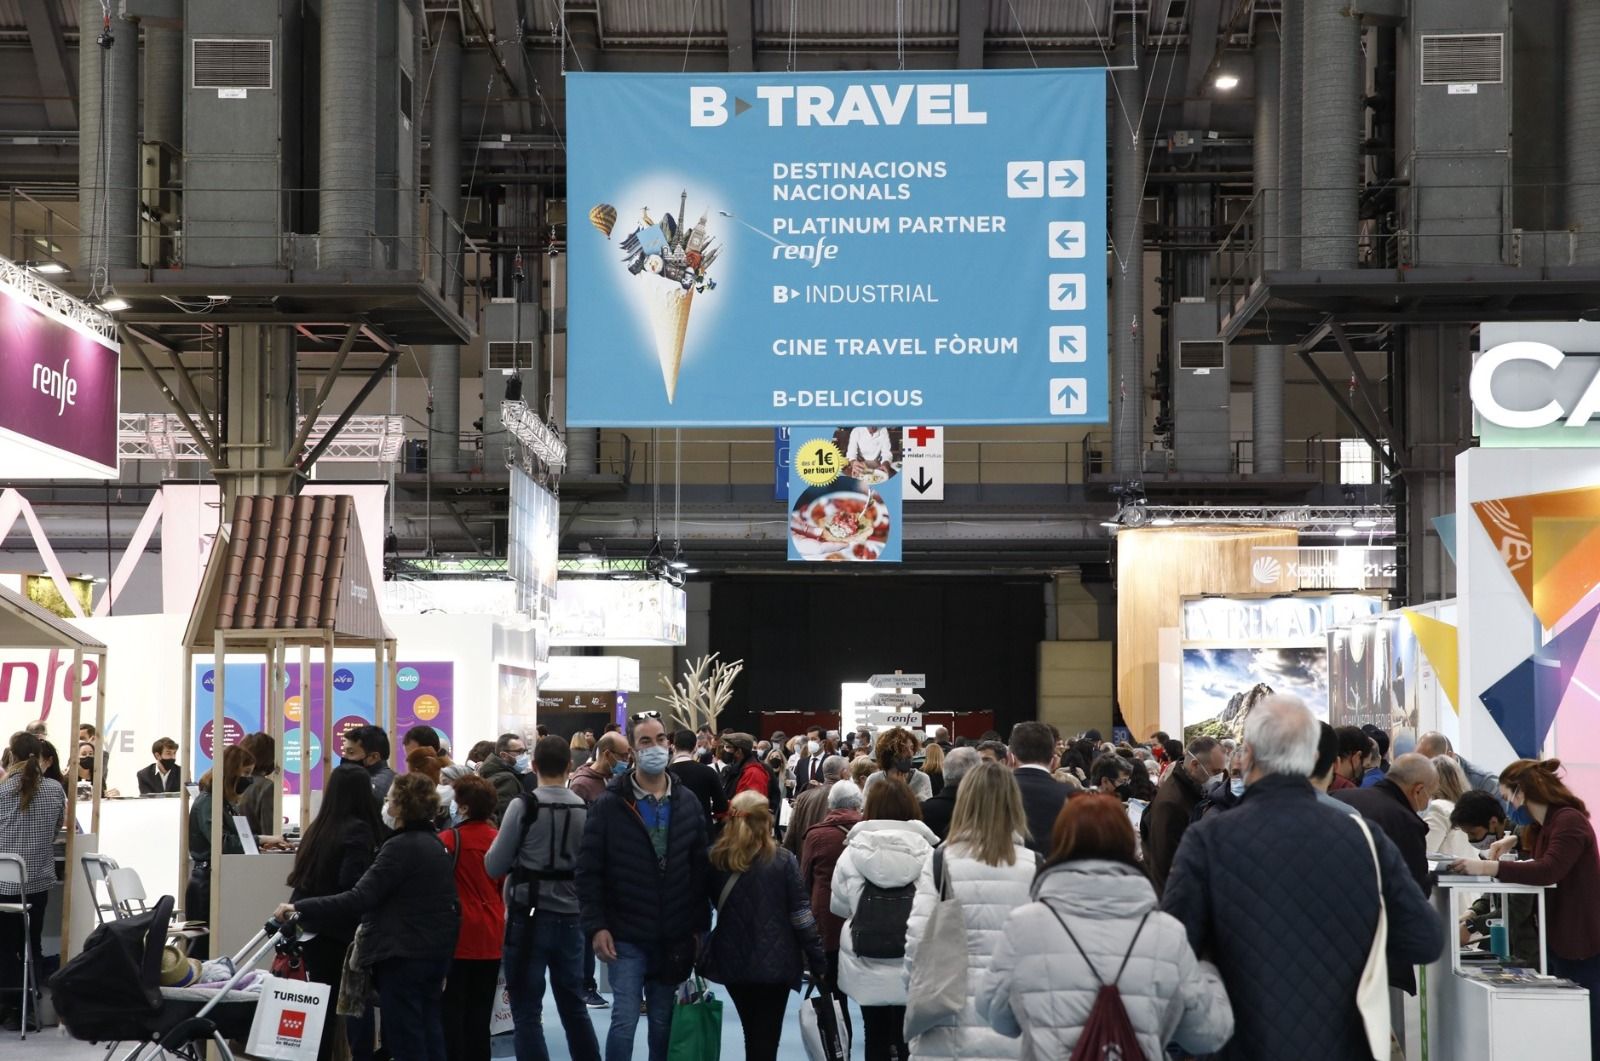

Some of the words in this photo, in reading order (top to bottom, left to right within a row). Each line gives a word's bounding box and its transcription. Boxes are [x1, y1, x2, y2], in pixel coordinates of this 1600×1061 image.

[690, 86, 728, 127] B
[757, 83, 987, 126] TRAVEL
[773, 161, 947, 180] DESTINACIONS
[773, 183, 911, 201] NACIONALS
[773, 217, 890, 235] PLATINUM
[898, 216, 1006, 234] PARTNER
[772, 236, 838, 268] renfe
[773, 286, 788, 304] B
[805, 284, 938, 304] INDUSTRIAL
[773, 338, 827, 356] CINE
[834, 337, 926, 355] TRAVEL
[934, 332, 1018, 355] FÒRUM
[32, 358, 78, 416] renfe
[773, 389, 923, 408] B-DELICIOUS
[815, 448, 834, 466] 1€
[887, 713, 918, 726] renfe
[273, 990, 320, 1006] TURISMO
